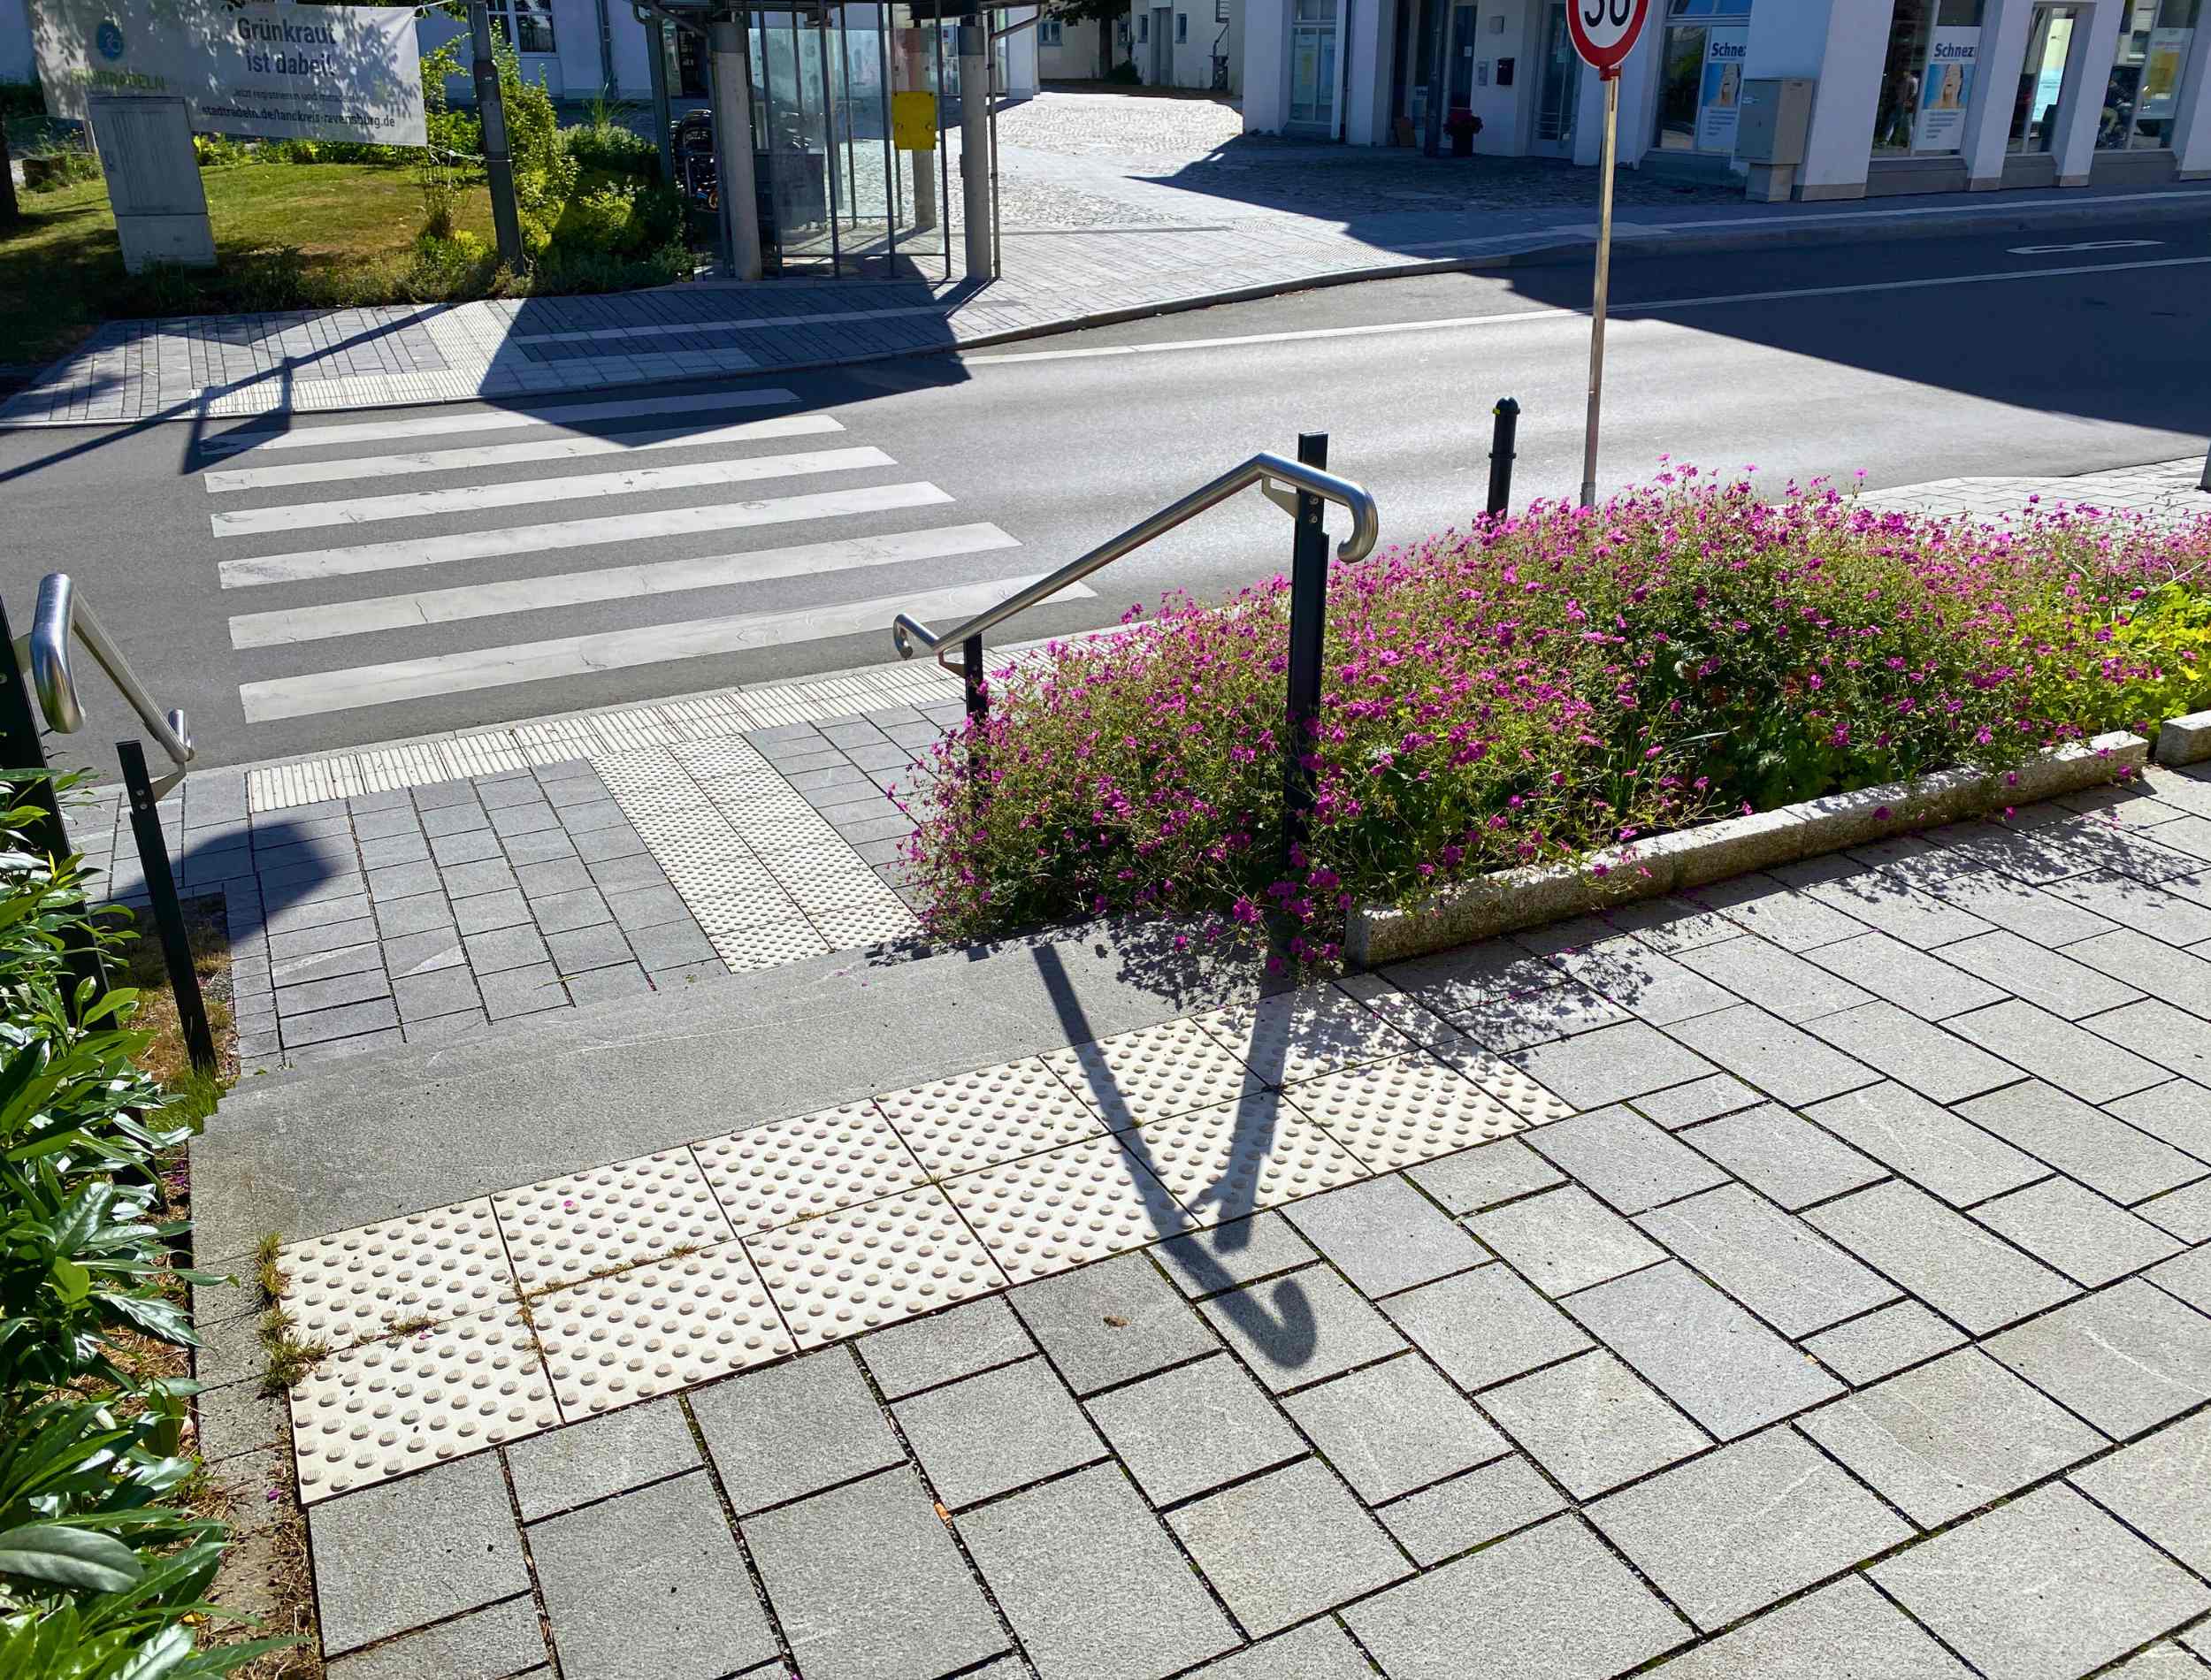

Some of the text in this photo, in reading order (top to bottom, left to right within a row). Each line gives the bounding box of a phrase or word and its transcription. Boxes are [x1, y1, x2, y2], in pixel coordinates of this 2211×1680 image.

[237, 17, 336, 44] Grünkraut
[246, 50, 336, 77] ist dabei!
